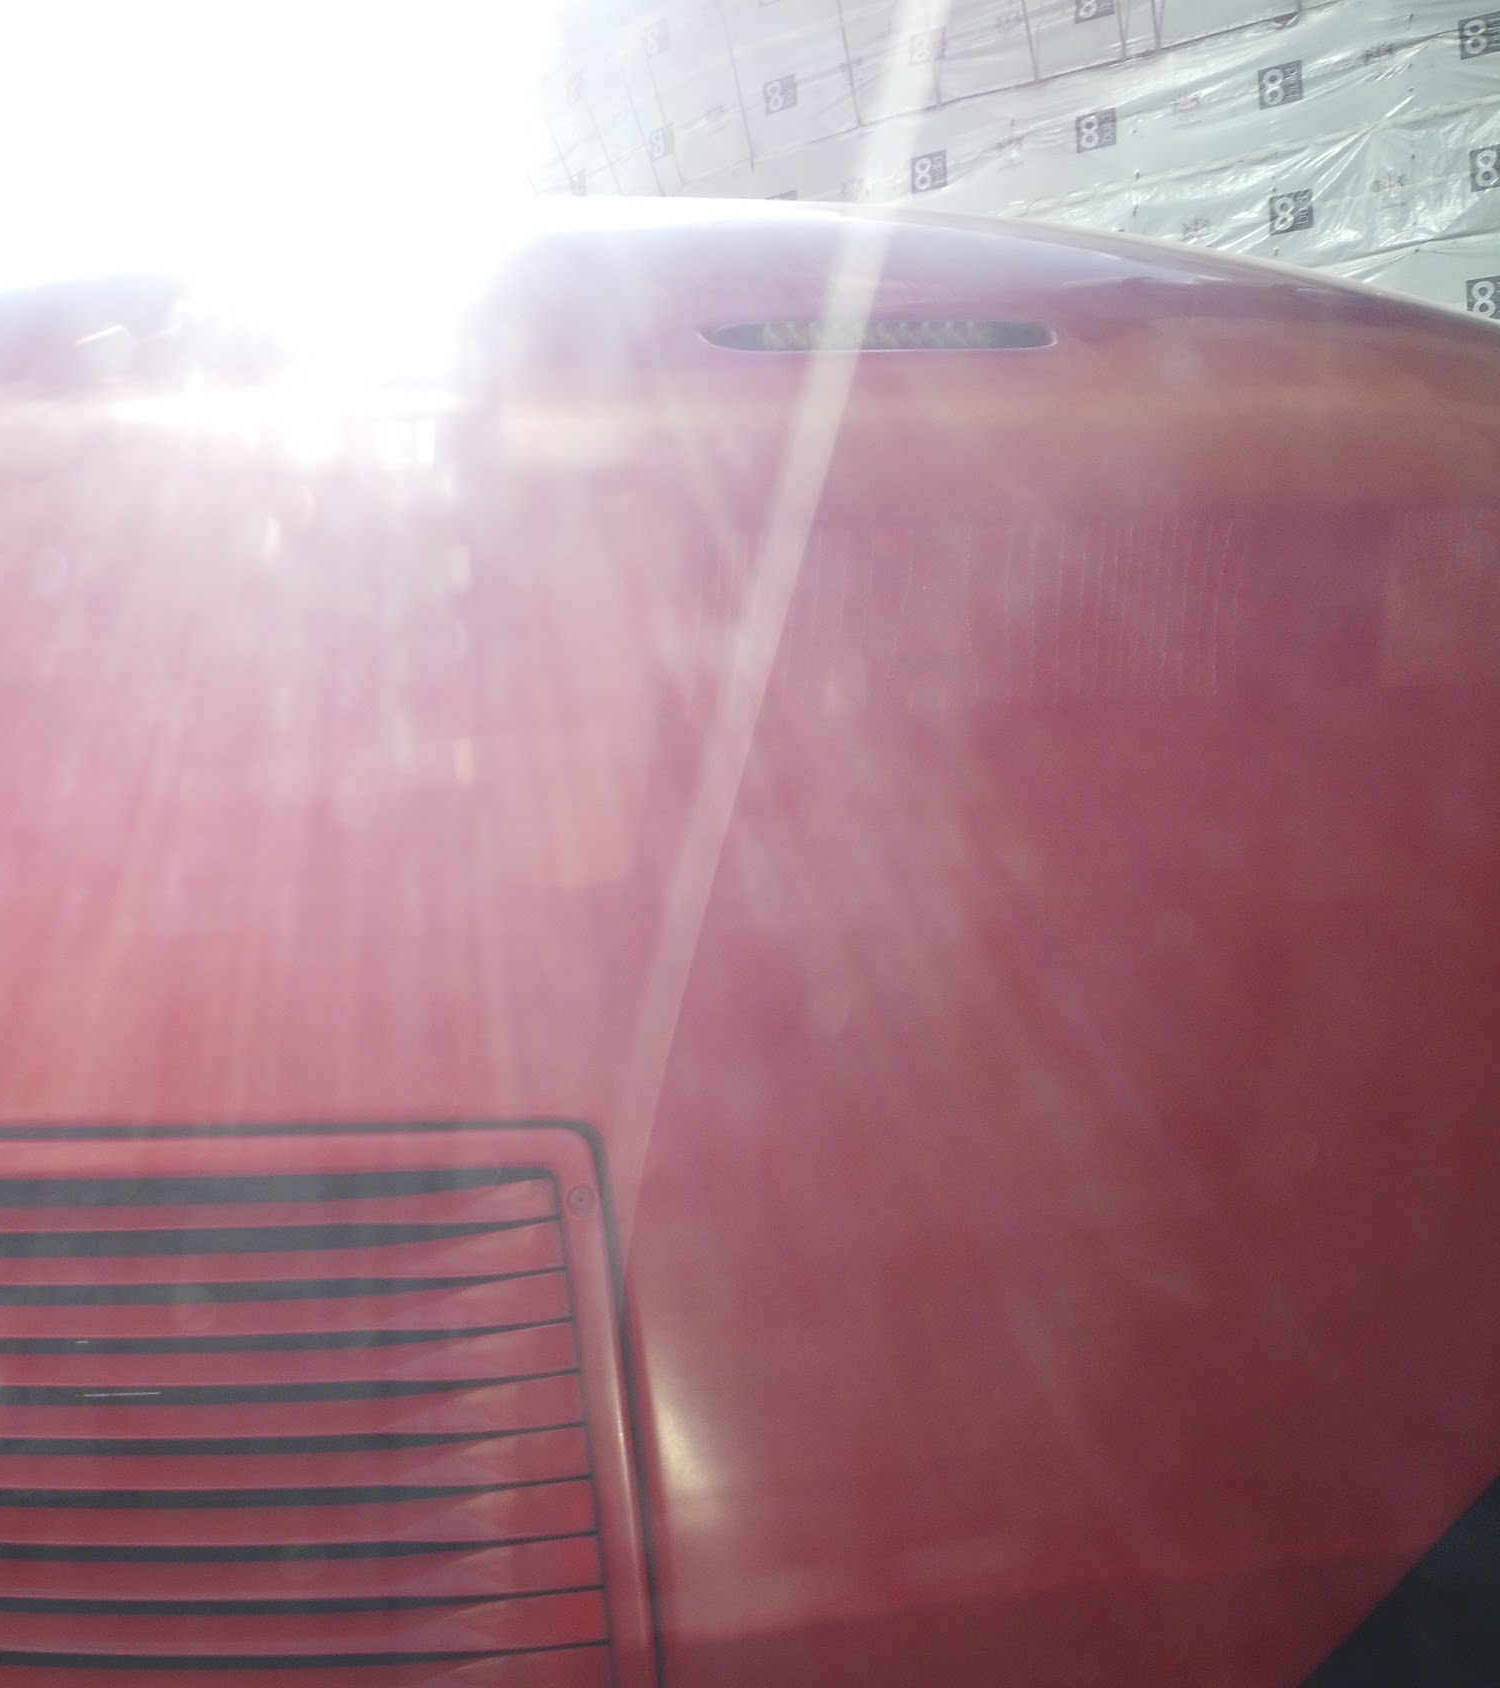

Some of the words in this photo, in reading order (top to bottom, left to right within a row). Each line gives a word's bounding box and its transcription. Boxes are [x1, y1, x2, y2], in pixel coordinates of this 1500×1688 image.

[1463, 20, 1487, 54] 8
[765, 81, 783, 111] 8
[1263, 69, 1285, 105] 8
[1079, 115, 1099, 149] 8
[914, 157, 932, 190] 8
[1475, 150, 1499, 187] 8
[1270, 197, 1294, 231] 8
[1471, 280, 1495, 318] 8
